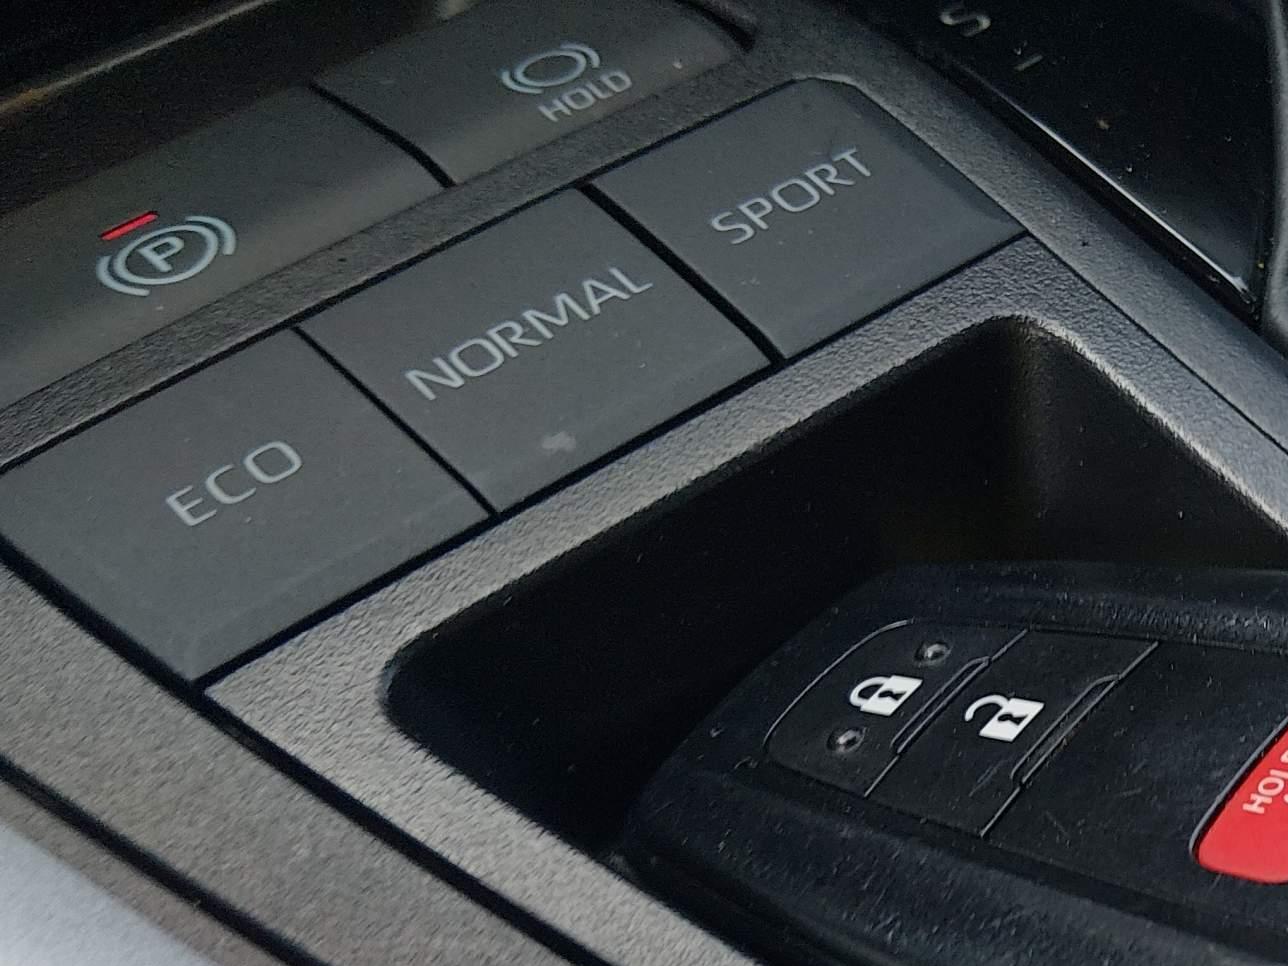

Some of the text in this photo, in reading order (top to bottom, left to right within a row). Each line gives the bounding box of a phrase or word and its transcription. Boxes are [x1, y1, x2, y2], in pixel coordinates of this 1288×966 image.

[939, 3, 992, 37] S
[537, 69, 634, 123] HOLD
[710, 146, 872, 245] SPORT
[143, 238, 186, 274] P
[404, 266, 654, 402] NORMAL
[165, 439, 303, 528] ECO
